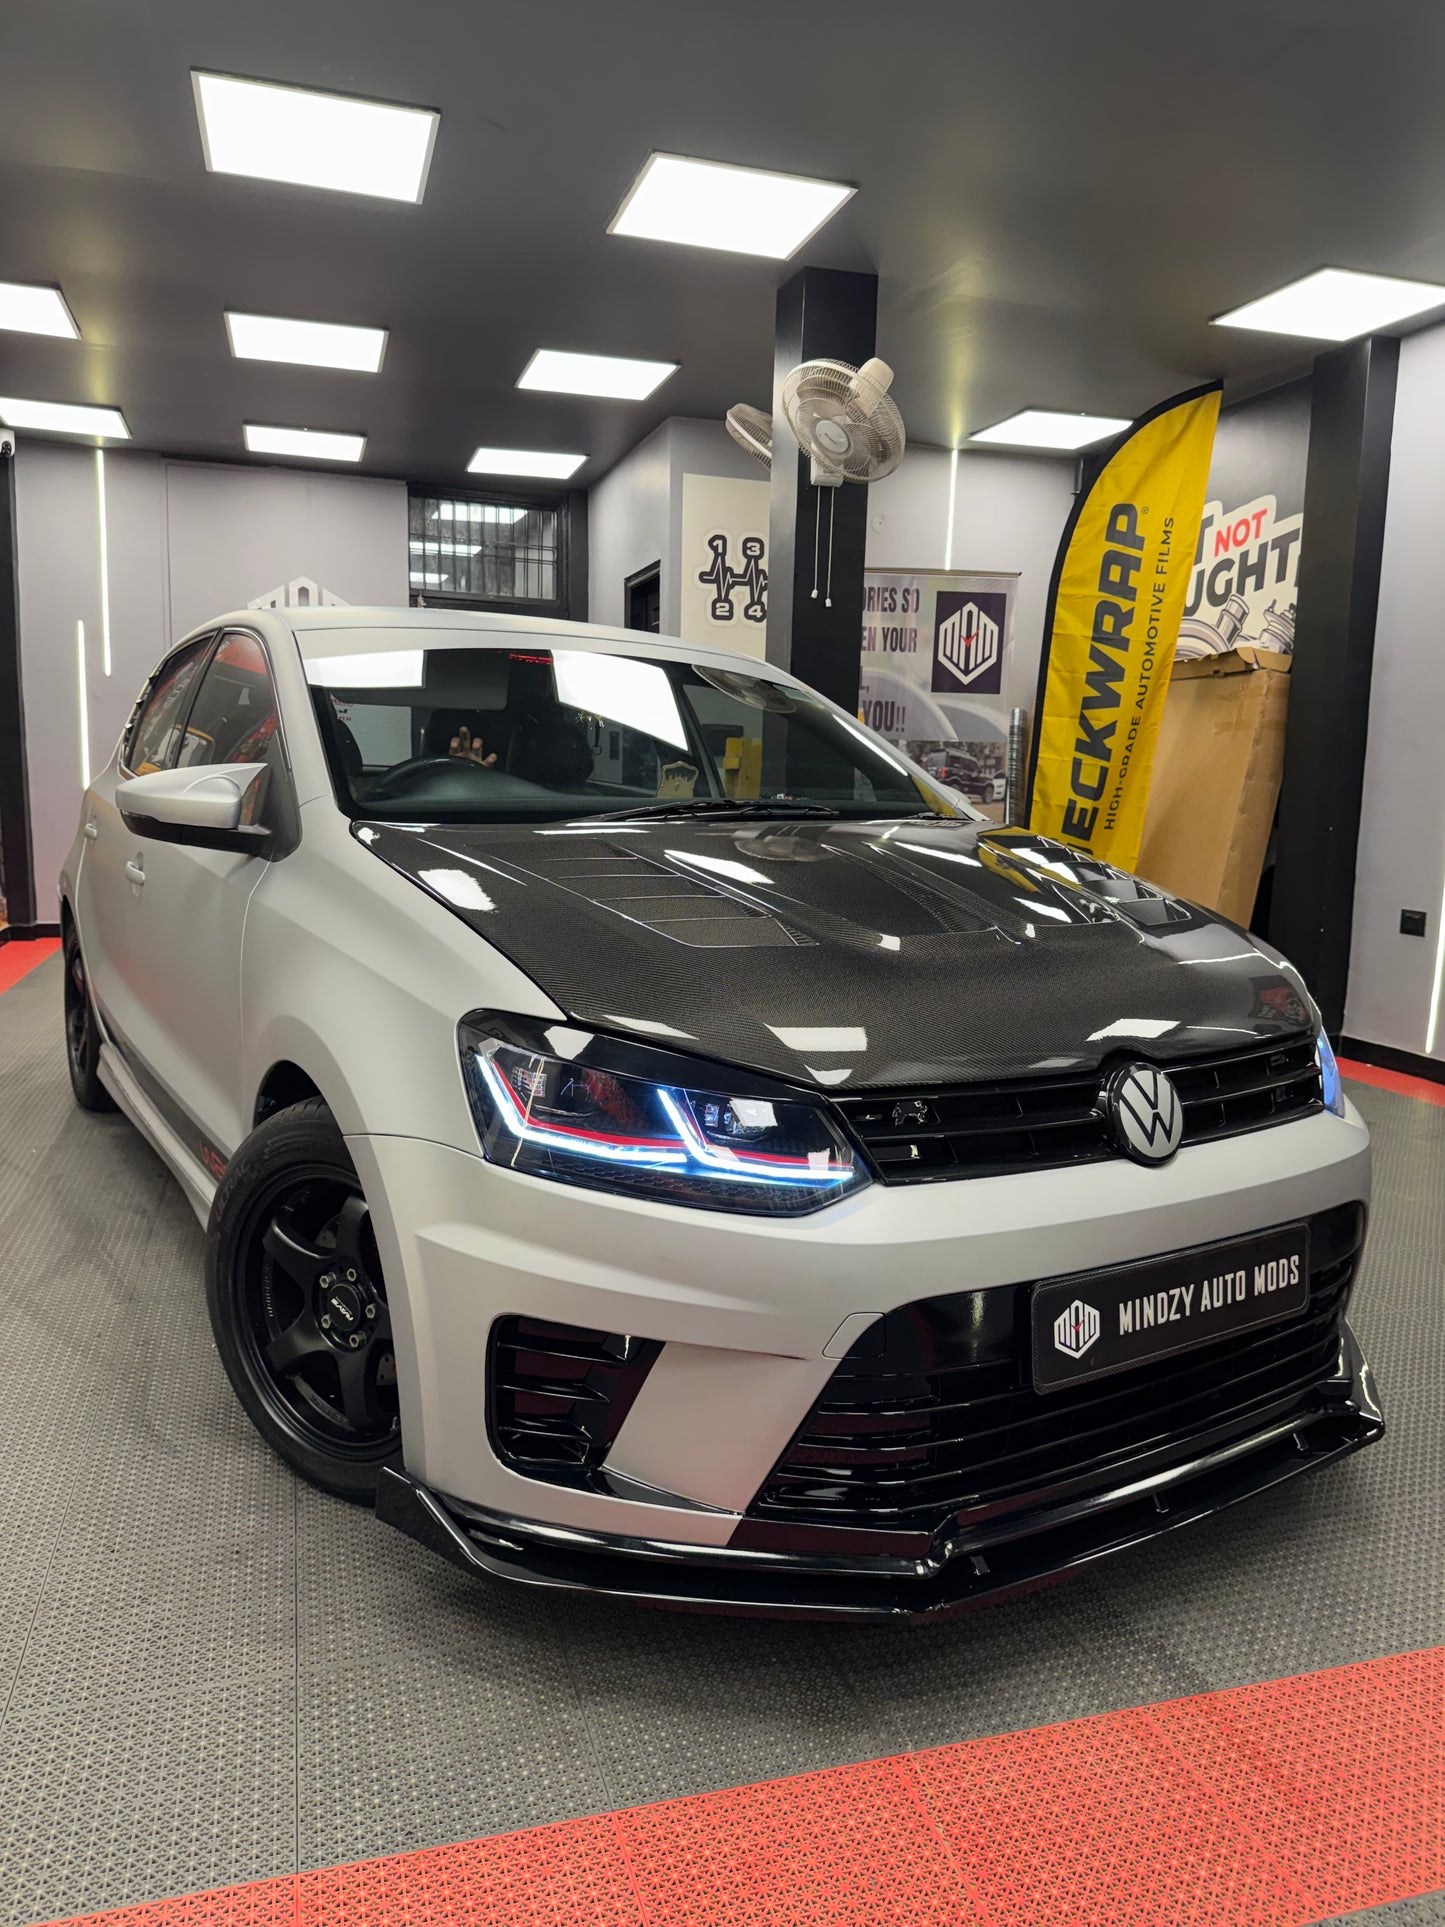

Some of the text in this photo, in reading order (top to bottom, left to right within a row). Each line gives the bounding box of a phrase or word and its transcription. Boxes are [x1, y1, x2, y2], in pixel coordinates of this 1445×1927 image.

[1183, 527, 1301, 617] UGHT
[1214, 508, 1268, 558] NOT
[882, 626, 918, 653] YOUR
[1103, 517, 1175, 830] HIGH-GRADE AUTOMOTIVE FILMS
[1118, 1283, 1195, 1336] MINDZY
[1200, 1269, 1247, 1313] AUTO
[1254, 1254, 1300, 1297] MODS
